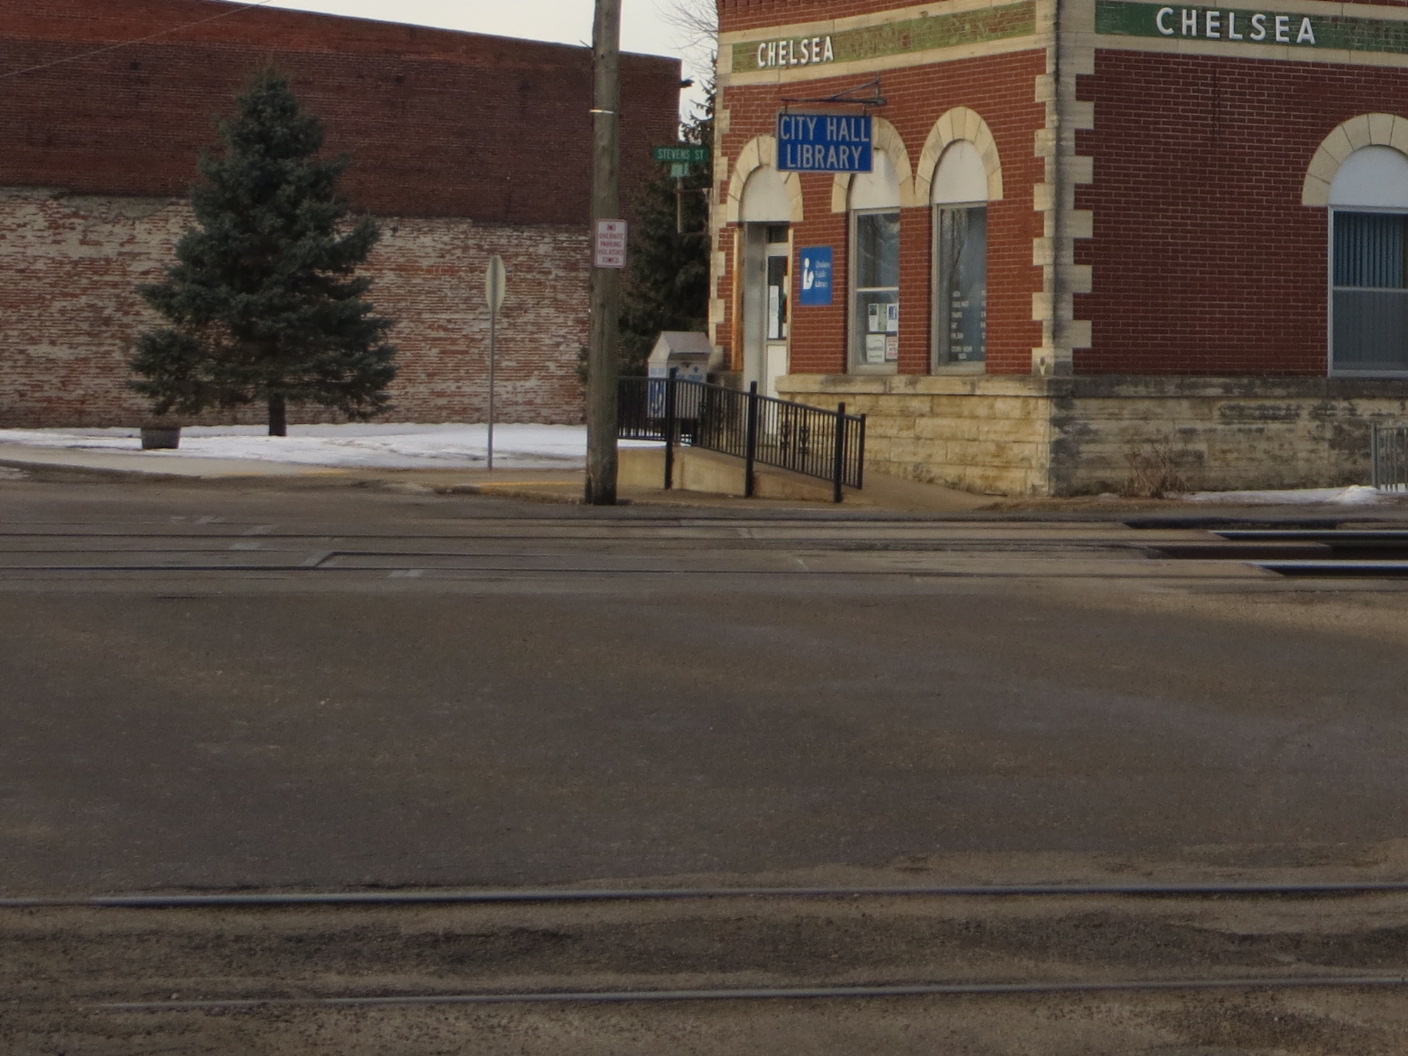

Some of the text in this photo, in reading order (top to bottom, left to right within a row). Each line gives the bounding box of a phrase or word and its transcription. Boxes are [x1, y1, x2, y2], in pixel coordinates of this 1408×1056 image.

[1155, 6, 1317, 45] CHELSEA
[757, 35, 835, 68] CHELSEA
[780, 115, 870, 142] CITY HALL
[657, 148, 704, 161] STEVENS ST
[786, 144, 863, 169] LIBRARY
